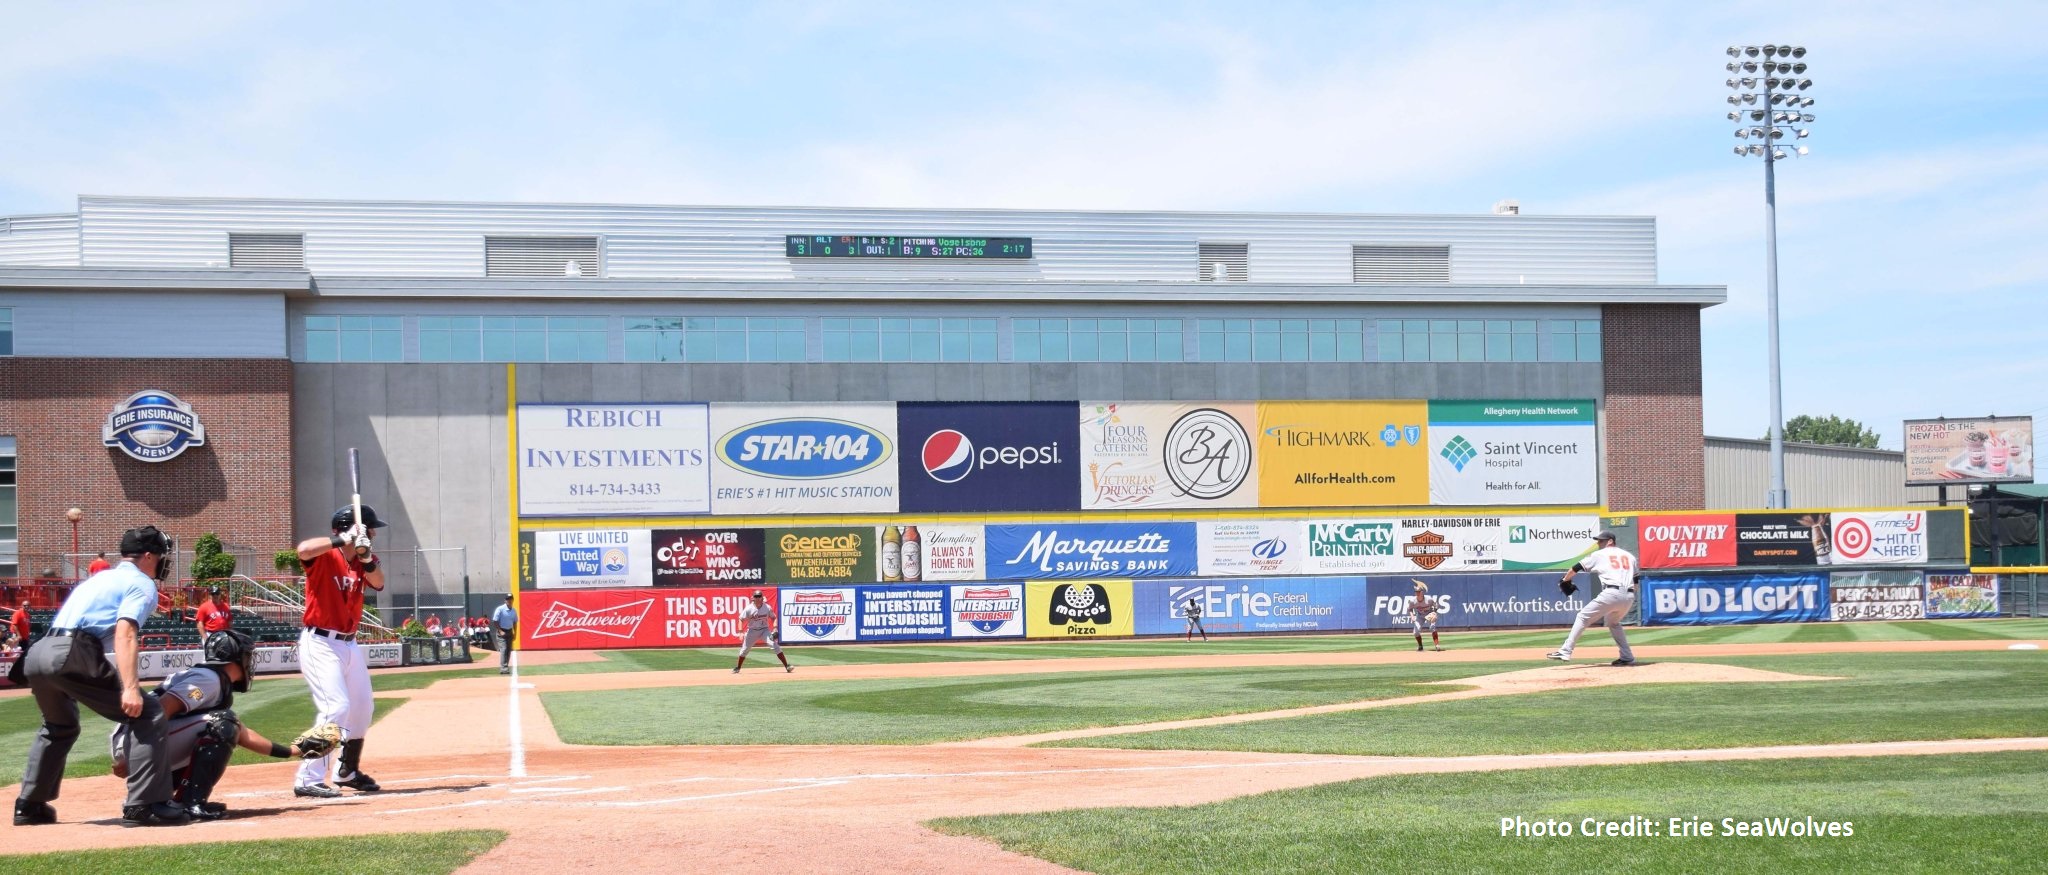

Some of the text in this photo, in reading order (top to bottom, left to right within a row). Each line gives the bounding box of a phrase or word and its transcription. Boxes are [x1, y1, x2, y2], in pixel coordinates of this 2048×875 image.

[1484, 408, 1520, 416] Allegheny
[1548, 407, 1578, 415] Network
[115, 408, 192, 427] ERIE INSURANCE
[1108, 426, 1146, 436] FOUR
[1910, 424, 1945, 432] FROZEN
[1278, 430, 1370, 447] HIGHMARK
[1933, 432, 1950, 440] HOT
[134, 446, 174, 457] ARENA
[1094, 444, 1148, 452] CATERING
[1484, 442, 1578, 454] Saint Vincent
[980, 441, 1058, 469] pepsi
[1485, 459, 1522, 468] Hospital
[1295, 473, 1395, 484] AllforHealth.com
[570, 483, 661, 496] 814-734-3433
[1486, 482, 1541, 490] Health for All.
[717, 486, 893, 499] ERIE'S #1 HIT MUSIC STATION
[1098, 485, 1154, 500] PRINCESS
[1402, 518, 1500, 528] HARLEY-DAVIDSON OF ERIE
[1875, 520, 1914, 528] FITNESS
[559, 531, 628, 545] LIVE UNITED
[705, 532, 738, 543] OVER
[926, 530, 979, 546] Yuengling
[1313, 524, 1393, 546] McCarty
[1529, 528, 1592, 539] Northwest
[1644, 525, 1728, 541] COUNTRY
[1790, 531, 1809, 539] MILK
[1887, 533, 1921, 544] HIT IT
[780, 534, 856, 552] General
[1416, 535, 1440, 543] MOTOR
[705, 545, 724, 555] 140
[932, 546, 974, 557] ALWAYS A
[1006, 530, 1170, 571] Marquette
[1312, 541, 1386, 556] PRINTING
[1668, 542, 1708, 558] FAIR
[1885, 545, 1921, 556] HERE!
[562, 550, 599, 560] United
[706, 557, 740, 568] WING
[931, 558, 974, 568] HOME RUN
[1056, 560, 1169, 571] SAVINGS BANK
[1417, 557, 1440, 566] CYCLES
[1609, 555, 1629, 570] 50
[576, 562, 599, 575] Way
[706, 568, 762, 580] FLAVORS!
[791, 566, 852, 578] 814.864.4984
[872, 592, 885, 600] you
[886, 590, 912, 599] haven't
[913, 590, 943, 599] shopped
[1273, 592, 1307, 603] Federal
[1654, 584, 1818, 614] BUD LIGHT
[665, 597, 707, 616] THIS
[865, 600, 941, 612] INTERSTATE
[954, 599, 1019, 611] INTERSTATE
[1206, 585, 1271, 618] Erie
[1463, 595, 1584, 614] www.fortis.edu
[784, 603, 852, 615] INTERSTATE
[1056, 603, 1107, 617] marco's
[1273, 605, 1332, 616] Credit Union
[542, 610, 641, 628] Budweiser
[791, 616, 845, 625] MITSUBISHI
[864, 613, 943, 626] MITSUBISHI
[959, 612, 1012, 621] MITSUBISHI
[666, 620, 701, 639] FOR
[1067, 625, 1096, 634] Pizza
[369, 649, 399, 658] CARTER
